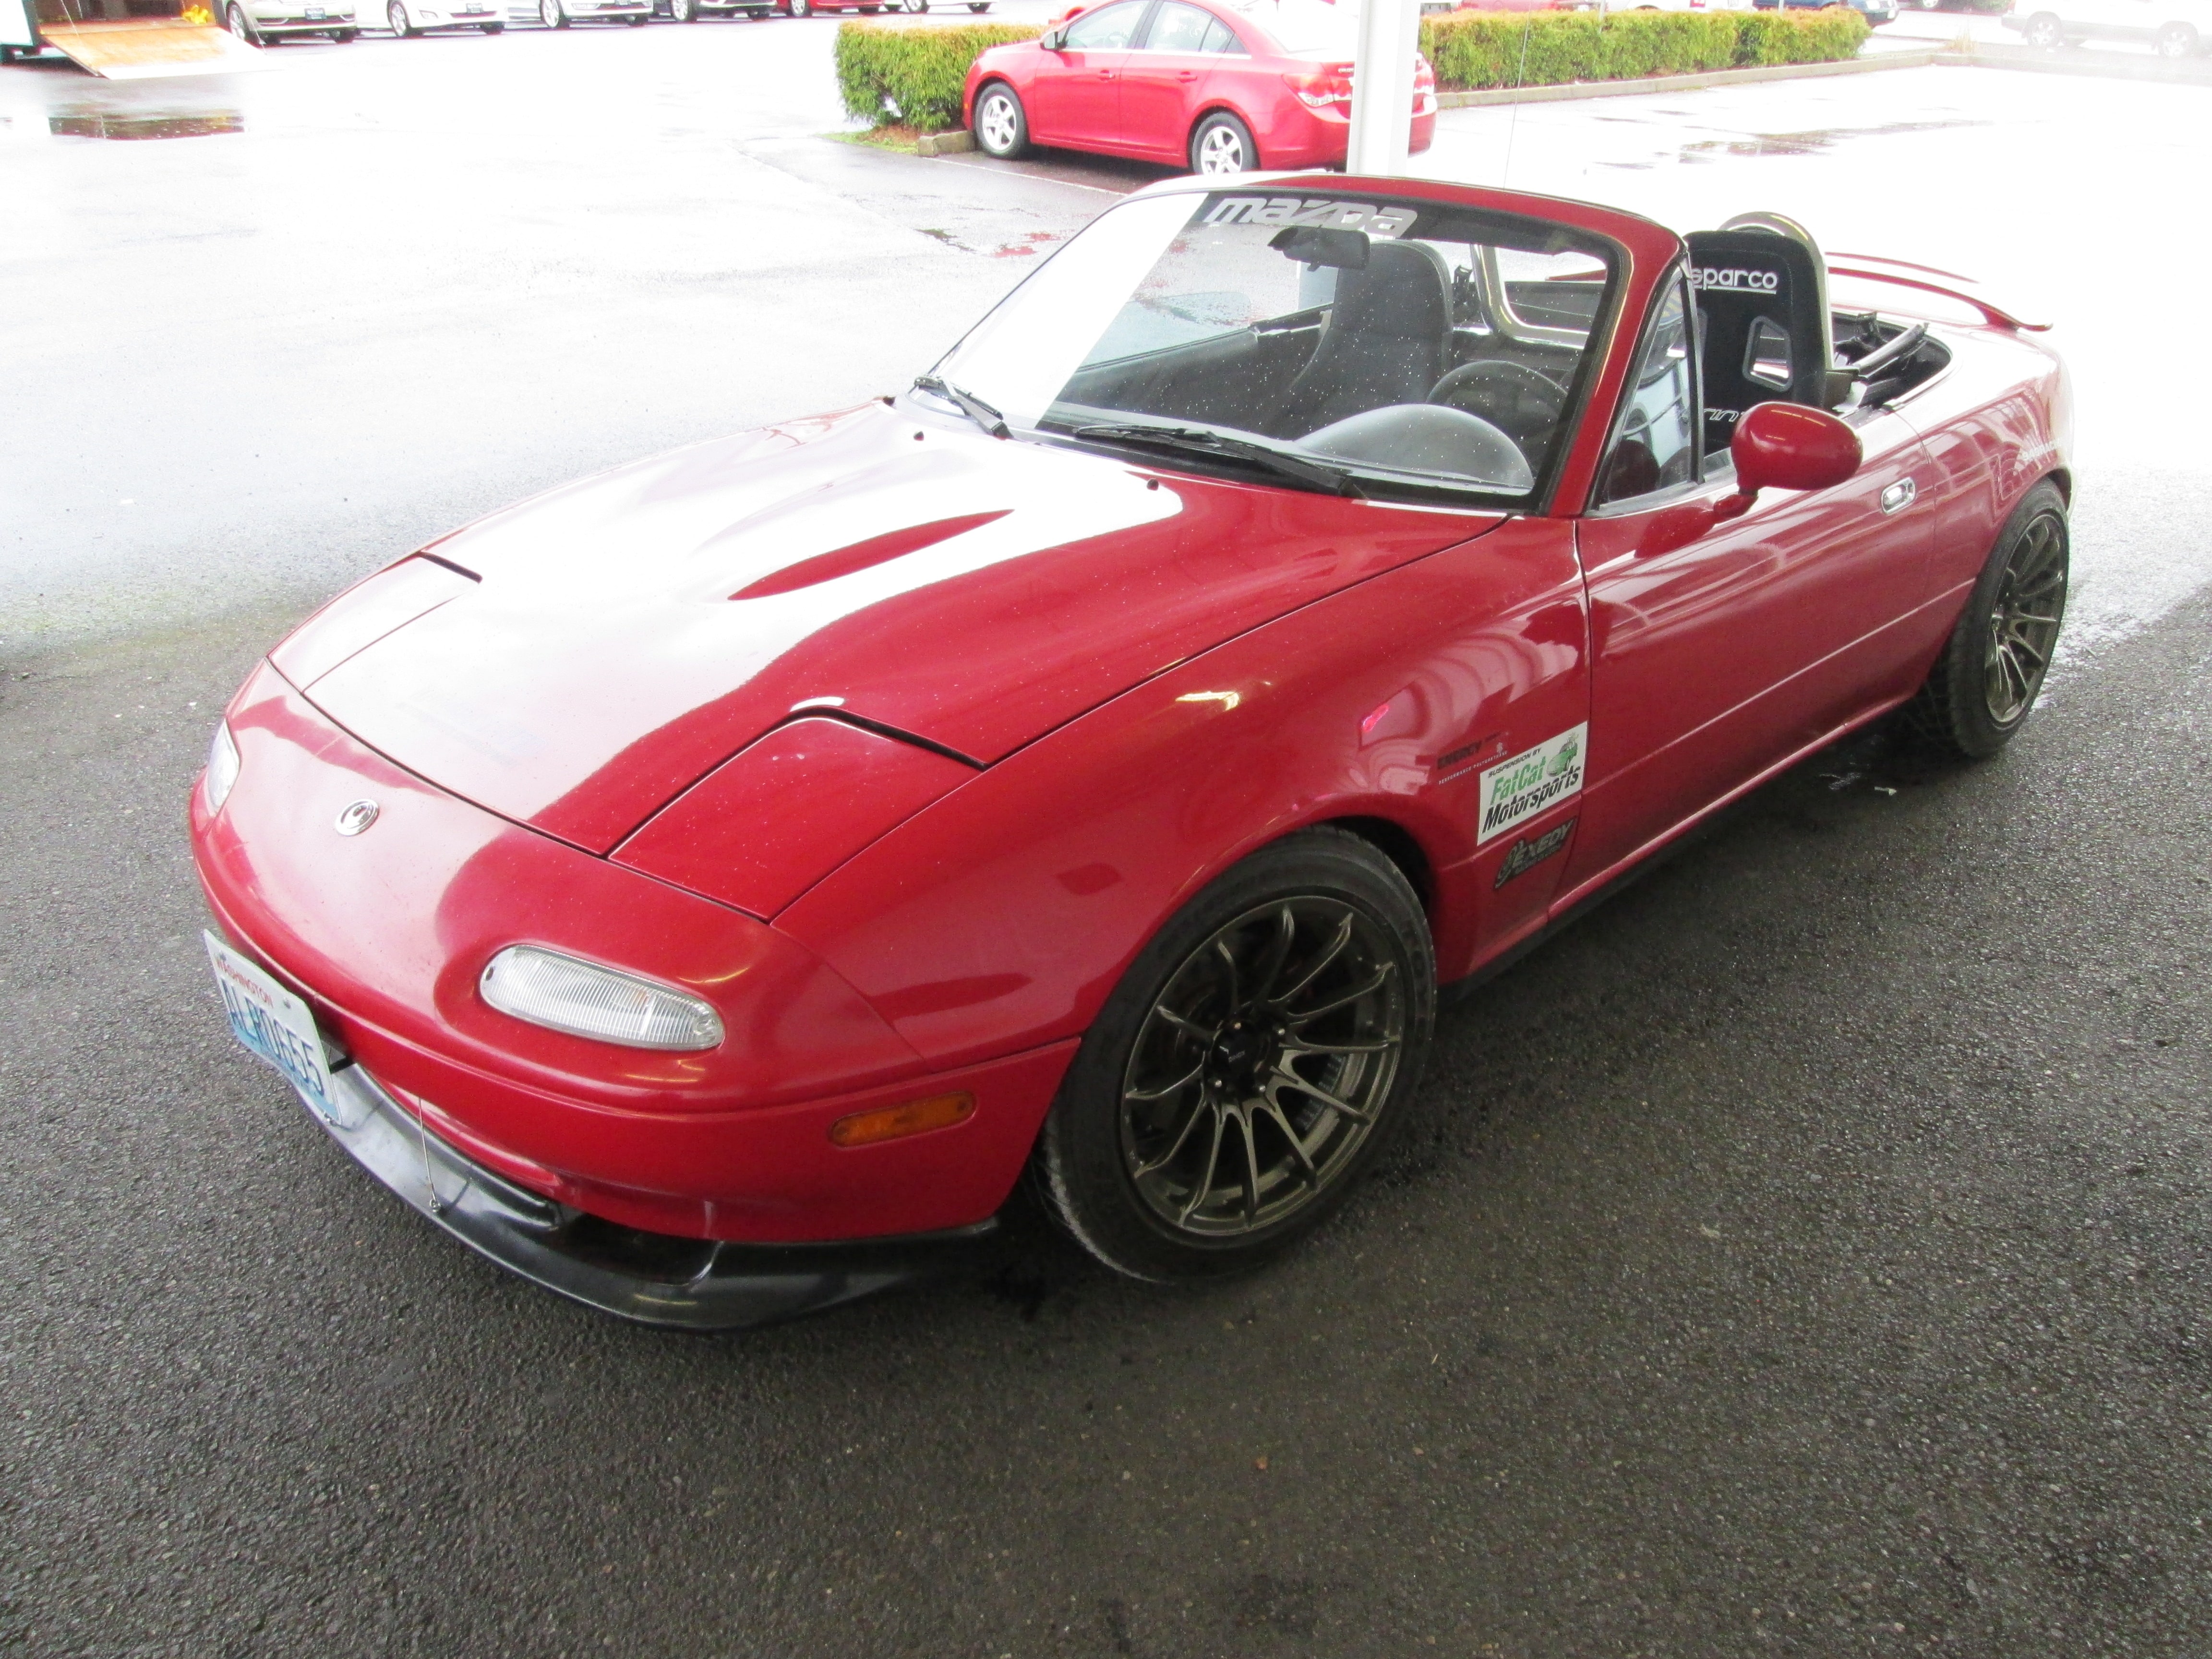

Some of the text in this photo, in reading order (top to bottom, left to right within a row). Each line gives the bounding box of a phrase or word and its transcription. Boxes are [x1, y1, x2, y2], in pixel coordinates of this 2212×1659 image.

[1203, 198, 1417, 238] mazda
[1692, 268, 1778, 290] sparco
[1488, 747, 1541, 778] SUSPENSION BY
[1491, 756, 1546, 805] FatCat
[1482, 765, 1581, 833] Motorsports
